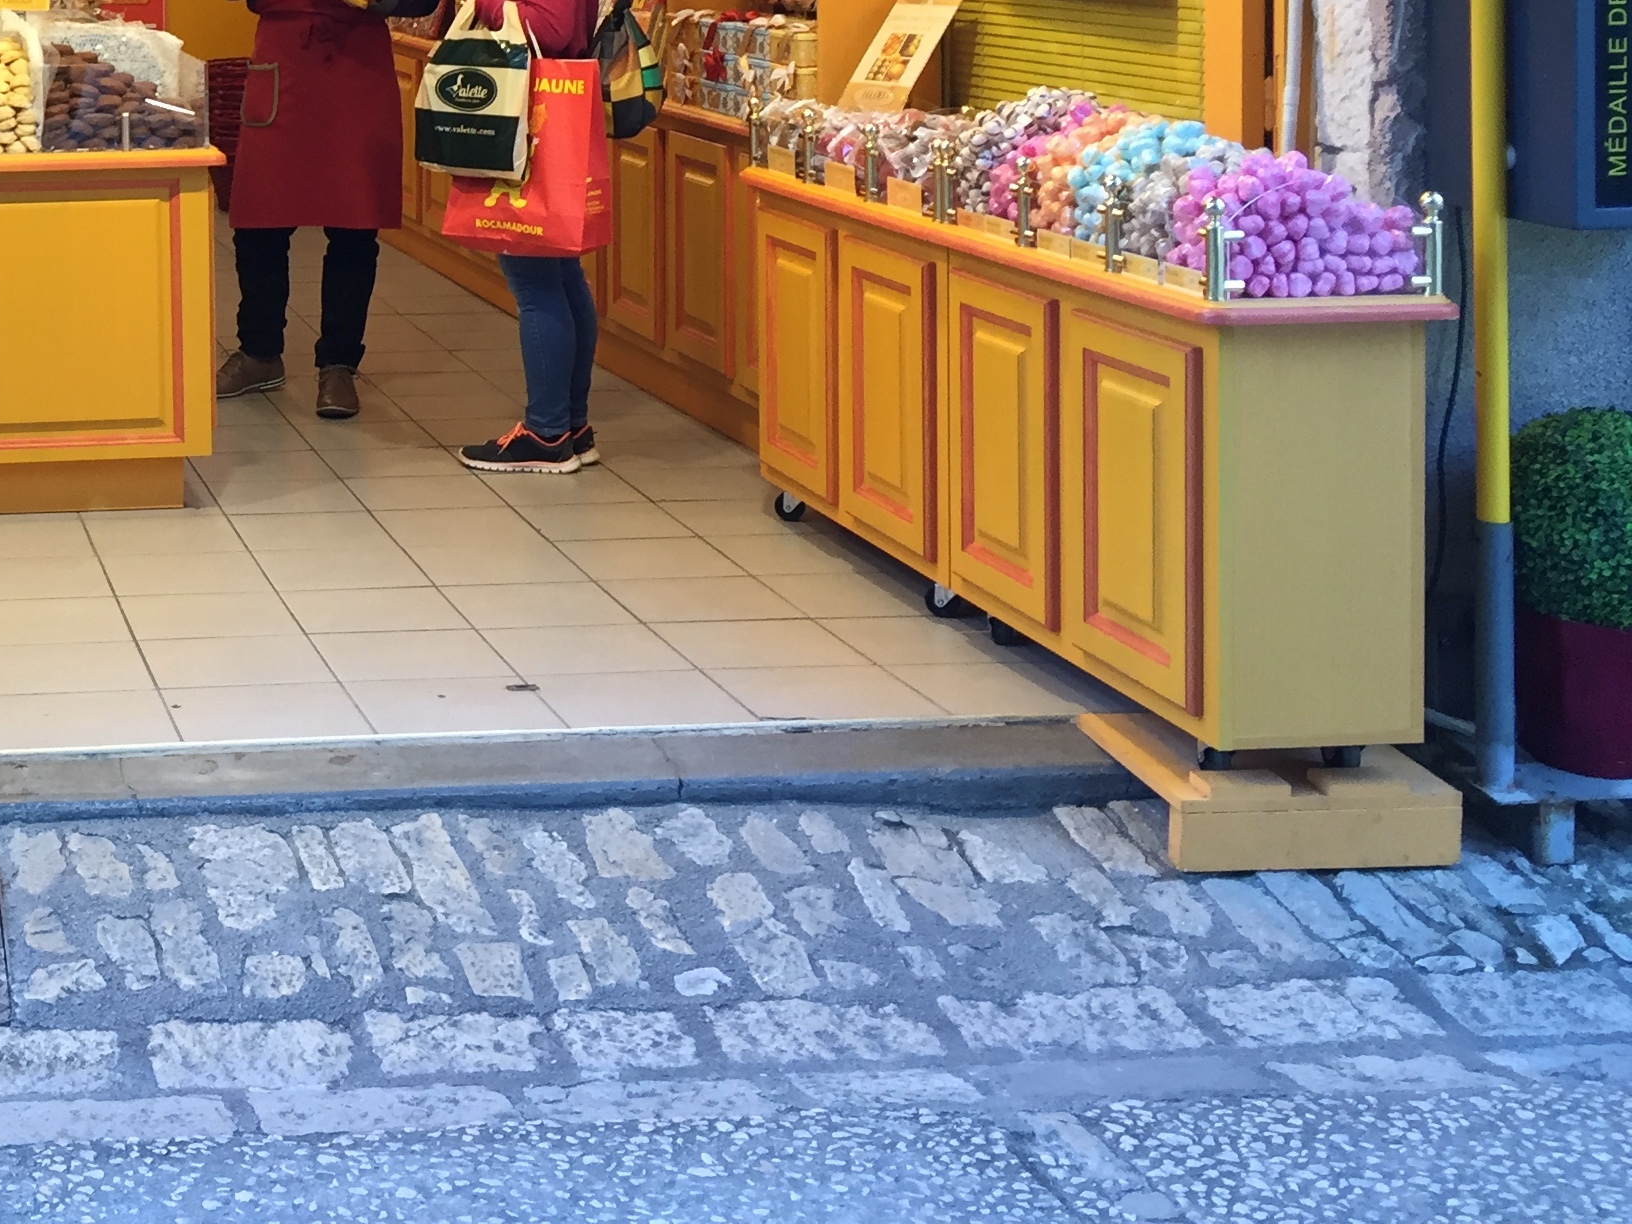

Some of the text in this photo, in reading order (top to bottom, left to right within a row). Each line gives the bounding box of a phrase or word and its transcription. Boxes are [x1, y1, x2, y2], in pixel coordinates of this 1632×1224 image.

[533, 77, 585, 95] JAUNE
[1604, 36, 1628, 177] MÉDAILLE
[475, 218, 544, 236] ROCAMADOUR
